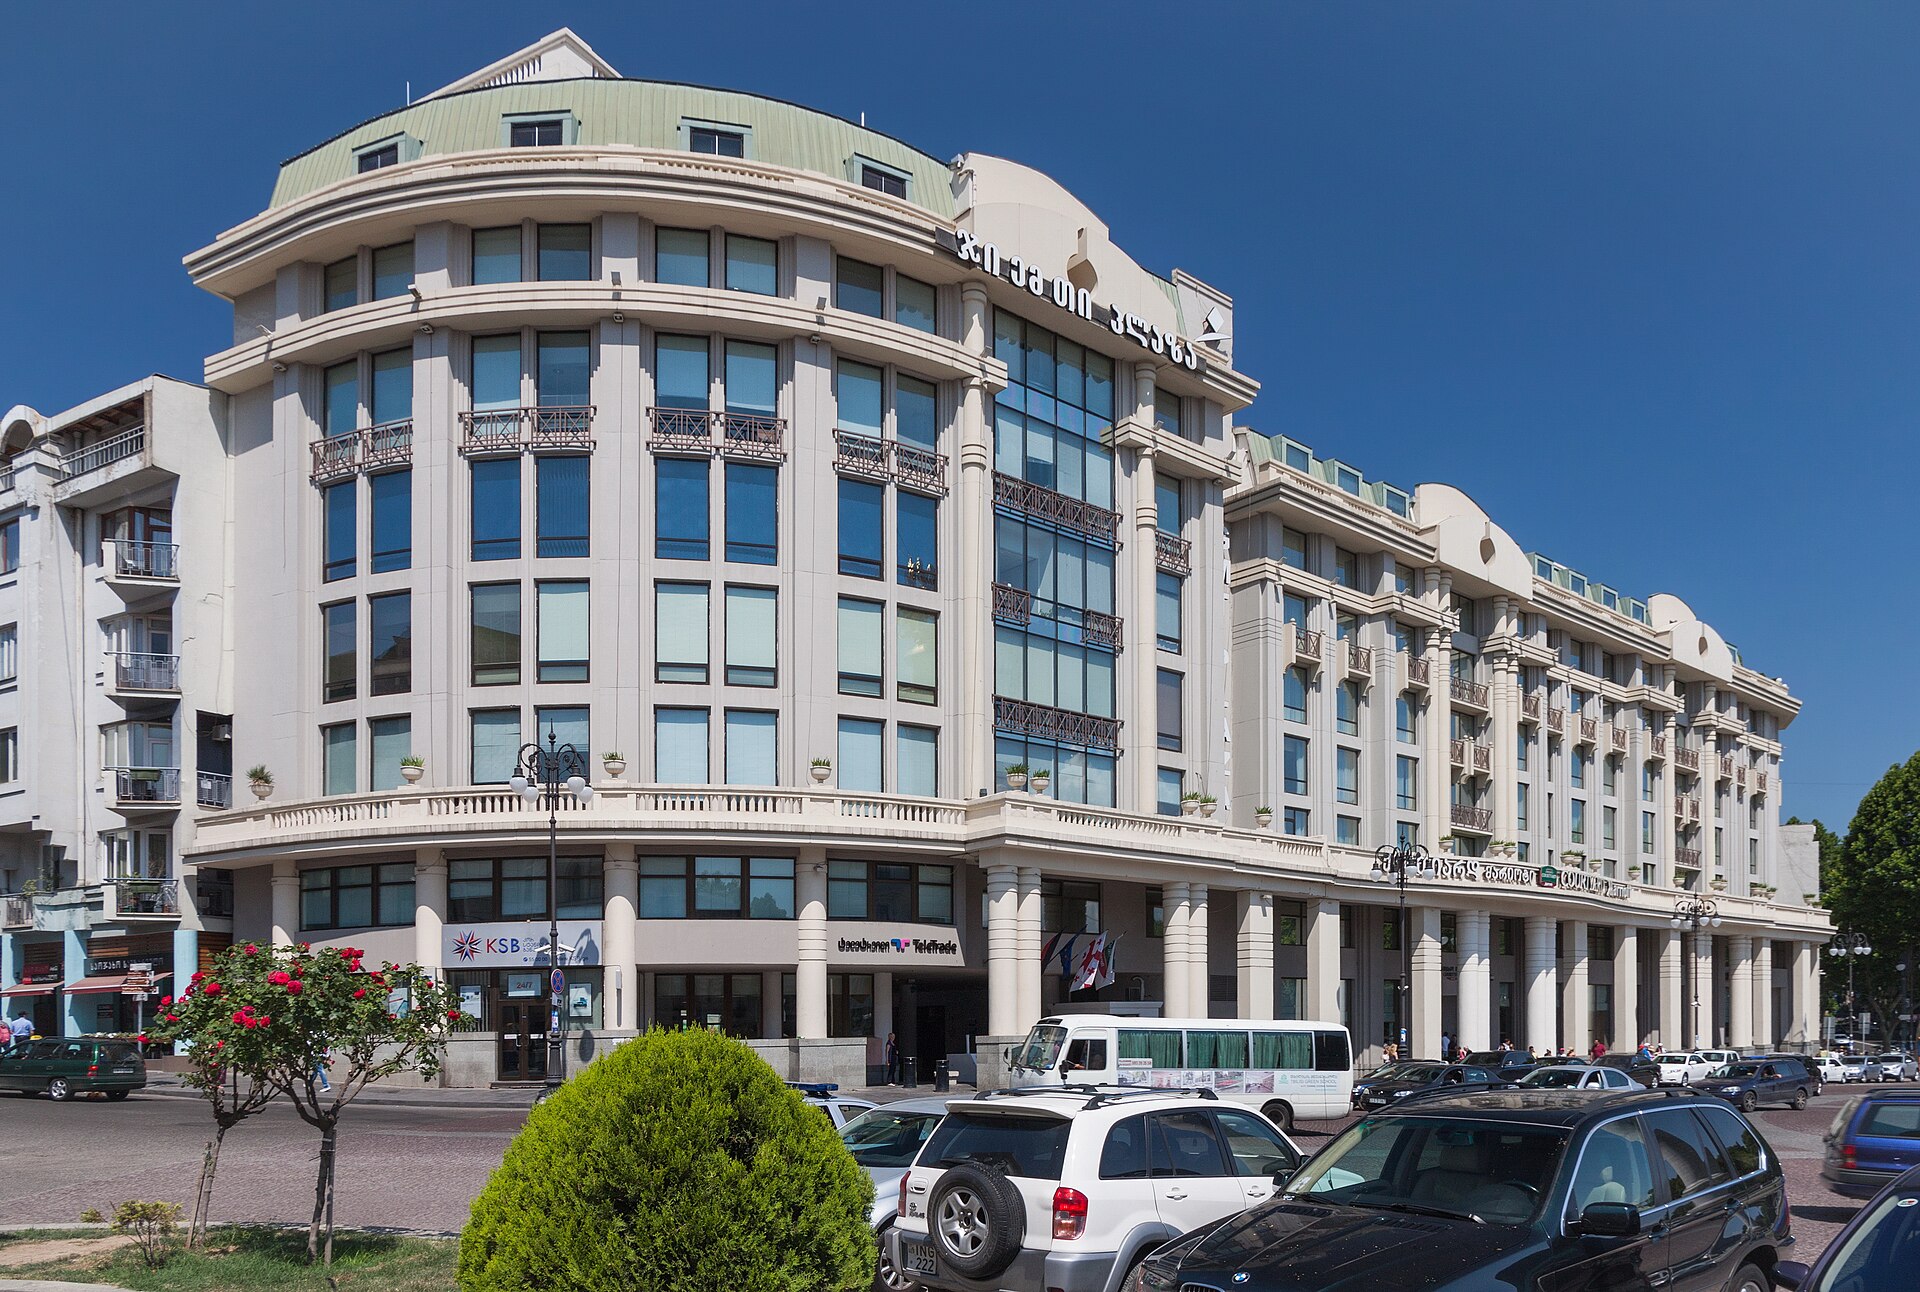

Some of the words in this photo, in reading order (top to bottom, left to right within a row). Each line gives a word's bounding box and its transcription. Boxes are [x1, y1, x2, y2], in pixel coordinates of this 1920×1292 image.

[955, 228, 1001, 277] ჯი
[1009, 255, 1044, 297] ემ
[1052, 276, 1093, 320] თი
[1110, 303, 1198, 370] პლაზა
[486, 938, 520, 953] KSB
[912, 939, 957, 954] TeleTrade
[516, 981, 533, 989] 24/7
[916, 1244, 935, 1259] ING
[915, 1257, 935, 1273] 222
